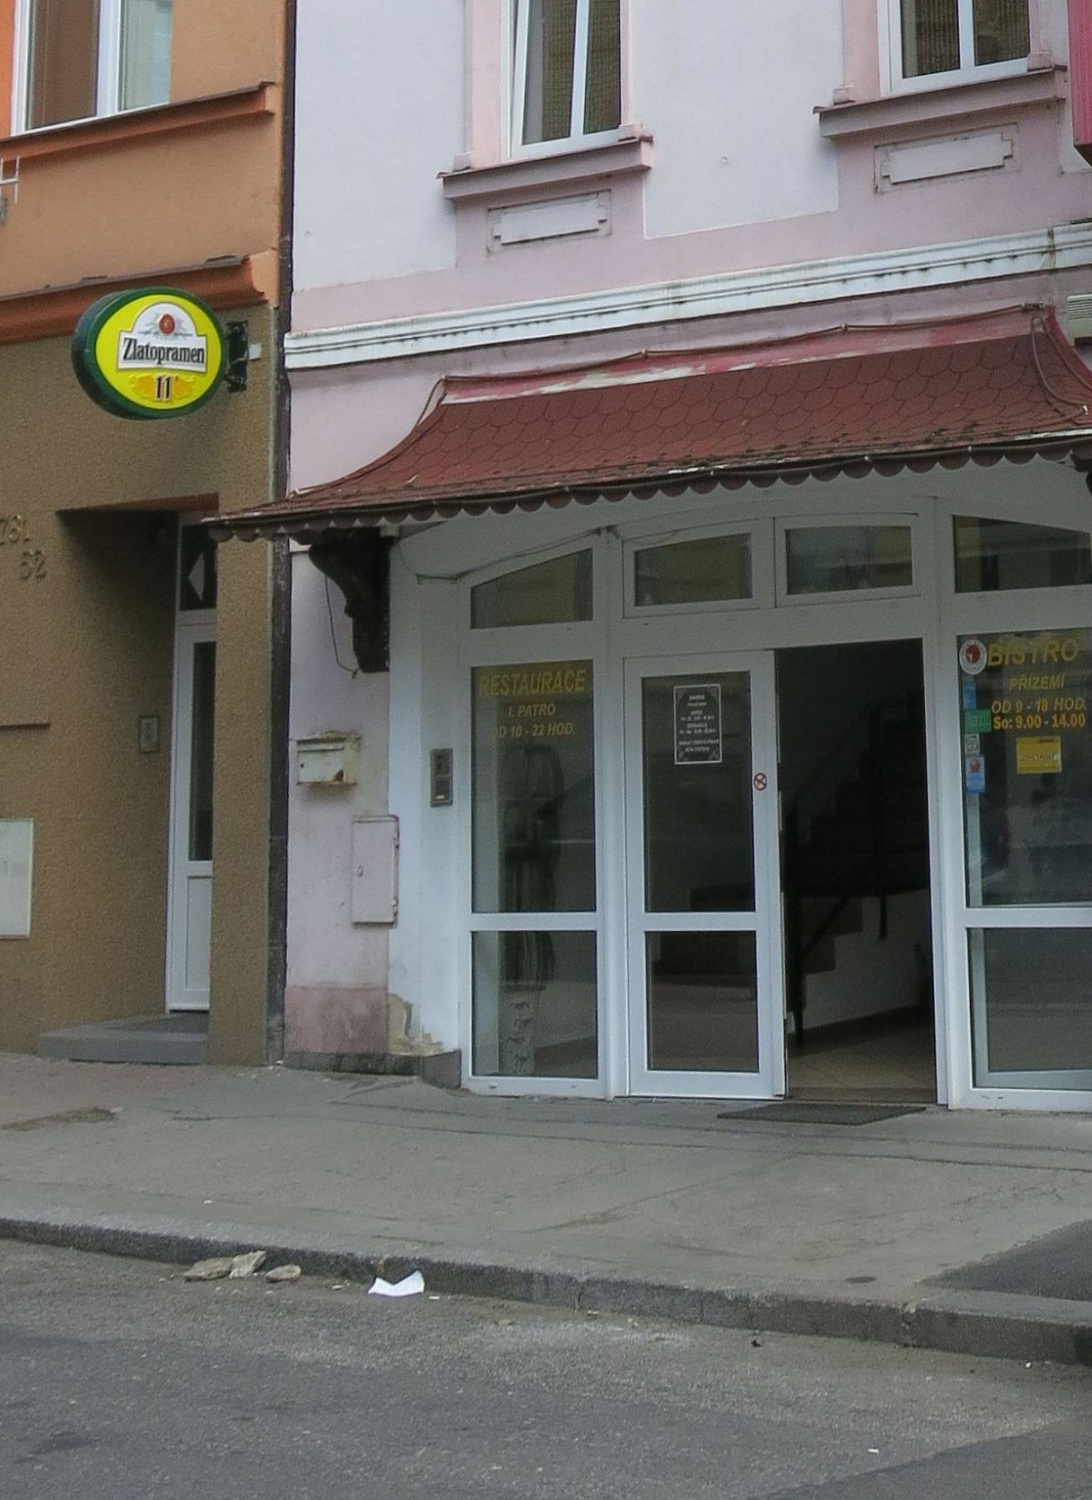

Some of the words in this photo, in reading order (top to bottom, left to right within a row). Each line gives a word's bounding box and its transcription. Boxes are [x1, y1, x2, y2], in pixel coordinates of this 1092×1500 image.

[123, 337, 205, 366] Zlatopramen
[987, 639, 1079, 667] BISTRO
[478, 669, 586, 697] RESTAURACE
[1009, 673, 1065, 691] PŘÍZEMÍ
[517, 703, 556, 717] PATRO
[991, 700, 1012, 714] OD
[1036, 699, 1049, 713] 18
[1054, 697, 1087, 711] HOD.
[510, 724, 523, 738] 10
[532, 723, 545, 737] 22
[547, 721, 576, 736] HOD.
[993, 715, 1013, 730] So:
[1015, 714, 1041, 730] 9.00
[1052, 712, 1086, 729] 14.00
